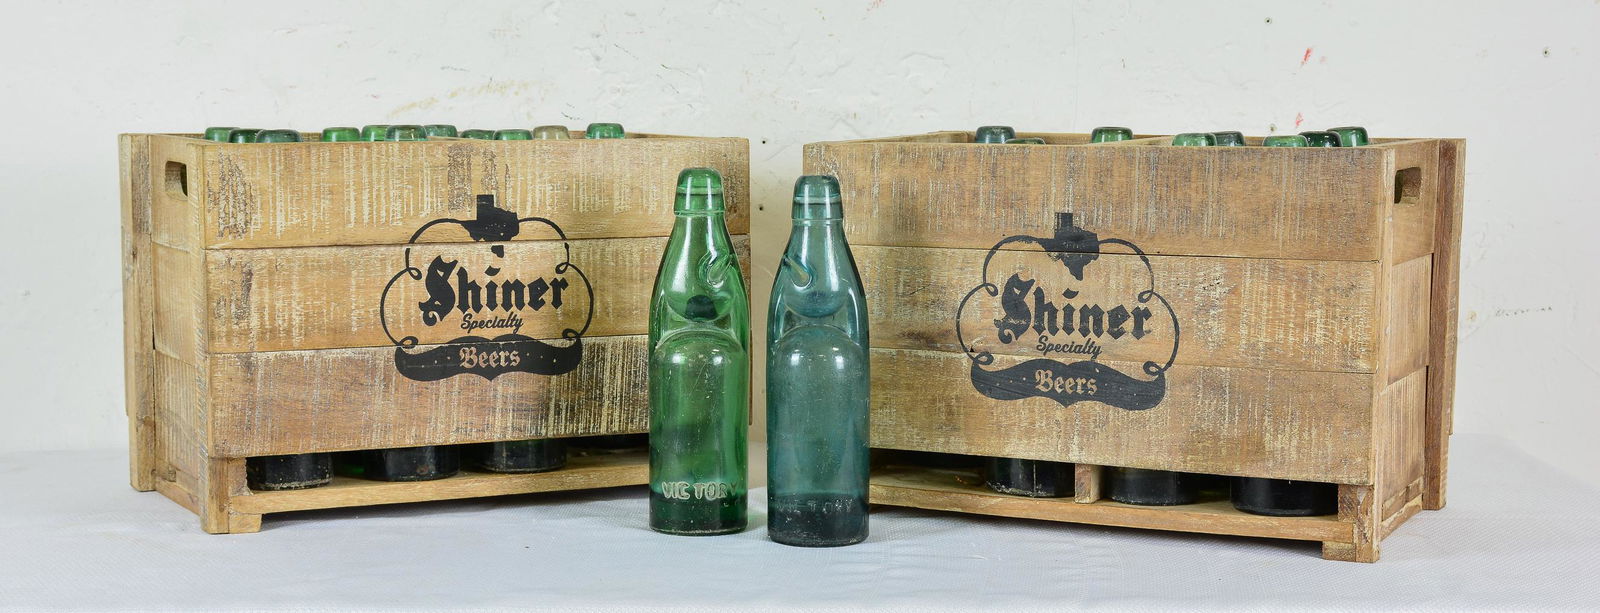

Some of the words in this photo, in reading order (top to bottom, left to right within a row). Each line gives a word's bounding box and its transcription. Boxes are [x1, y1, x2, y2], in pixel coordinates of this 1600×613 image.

[418, 255, 569, 327] Shiner
[993, 273, 1153, 345] Shiner
[460, 311, 524, 334] Specialty
[459, 346, 521, 369] Beers
[1036, 334, 1103, 360] Specialty
[1034, 369, 1098, 395] Beers
